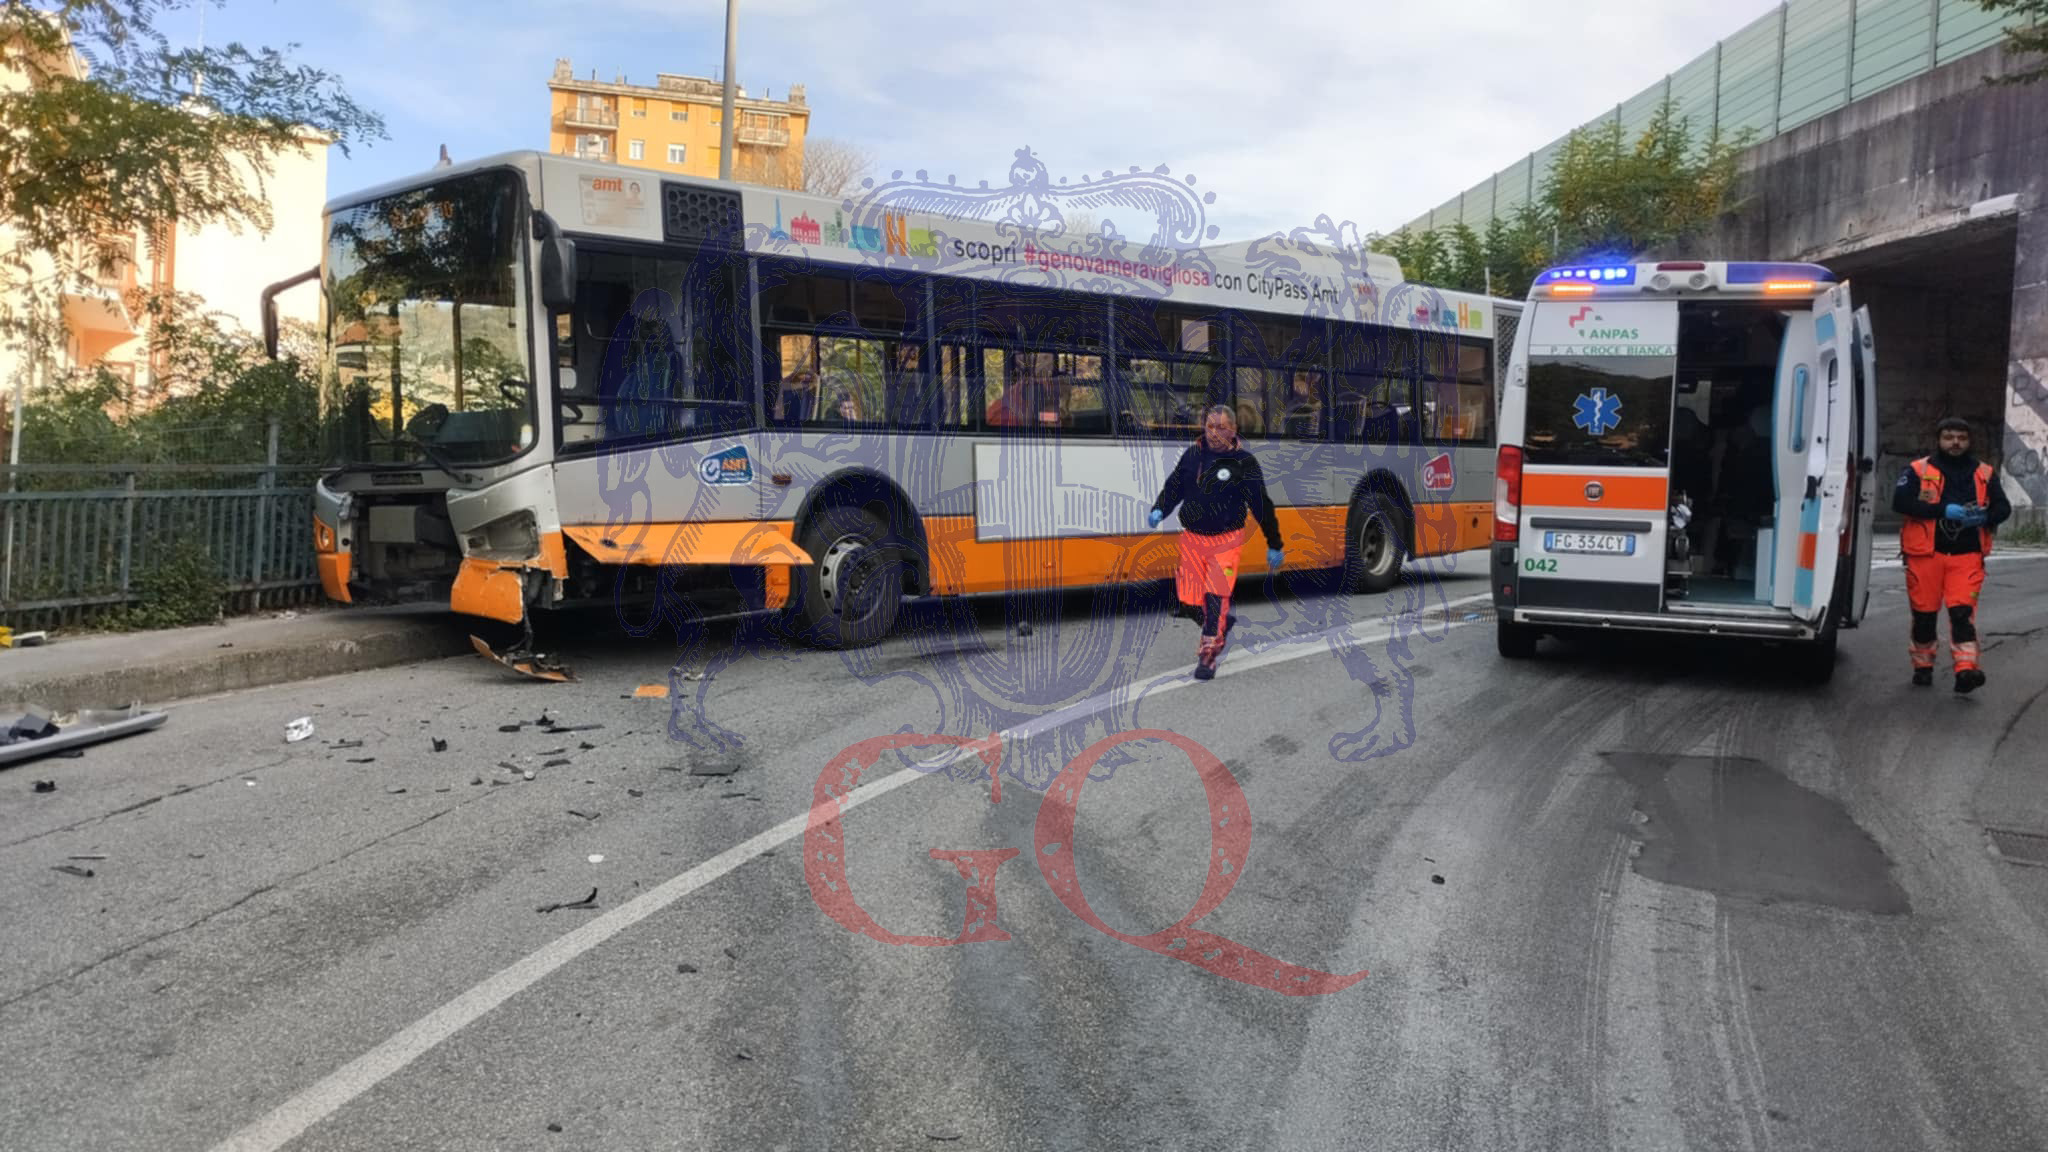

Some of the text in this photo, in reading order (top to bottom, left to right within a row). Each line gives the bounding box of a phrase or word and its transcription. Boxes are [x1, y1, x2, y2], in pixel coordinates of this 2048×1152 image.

[593, 176, 623, 192] amt
[954, 239, 1339, 304] scopri #genovameravigliosa con CityPass Amt
[1590, 328, 1639, 340] ANPAS
[1582, 345, 1619, 356] CROCE
[1627, 345, 1674, 356] BIANCA
[1524, 558, 1558, 572] 042
